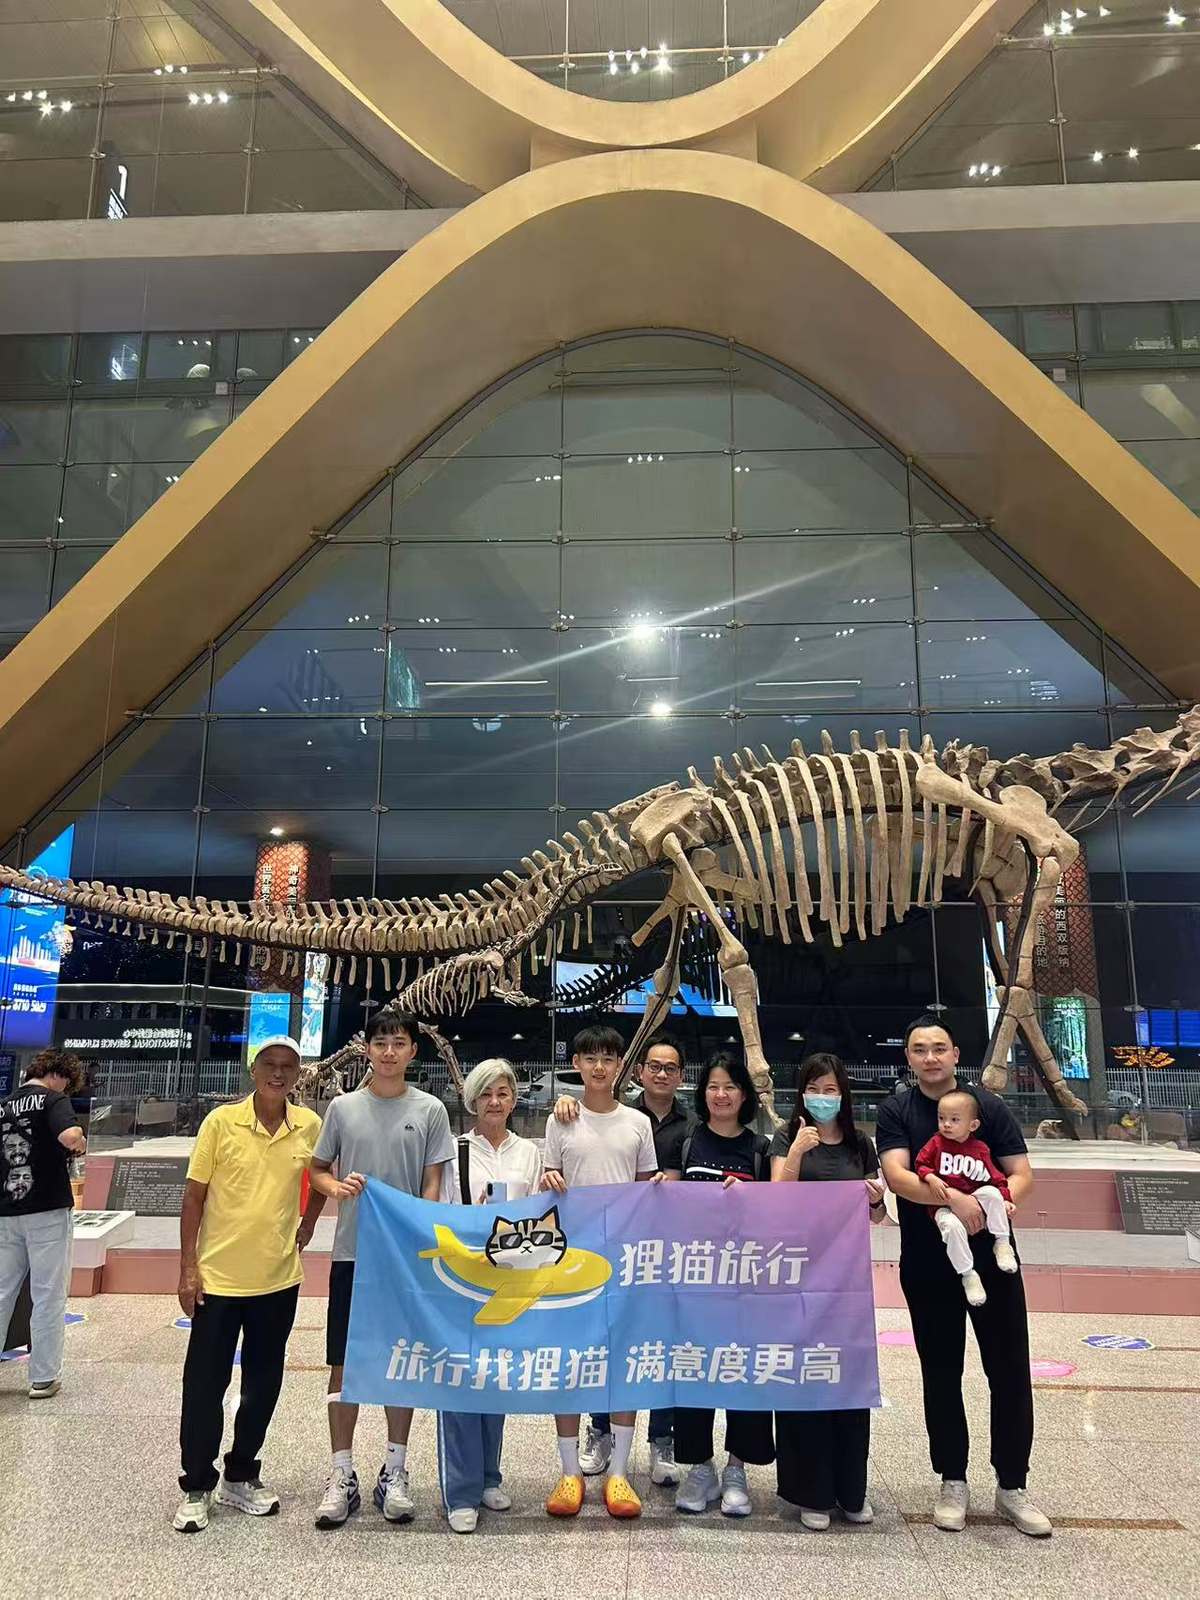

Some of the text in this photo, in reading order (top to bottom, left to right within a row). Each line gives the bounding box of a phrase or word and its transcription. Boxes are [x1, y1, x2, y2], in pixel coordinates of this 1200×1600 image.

[939, 1152, 991, 1182] BOOM
[619, 1239, 809, 1287] 狸猫旅行
[385, 1337, 842, 1392] 旅行找狸猫 满意度更高
